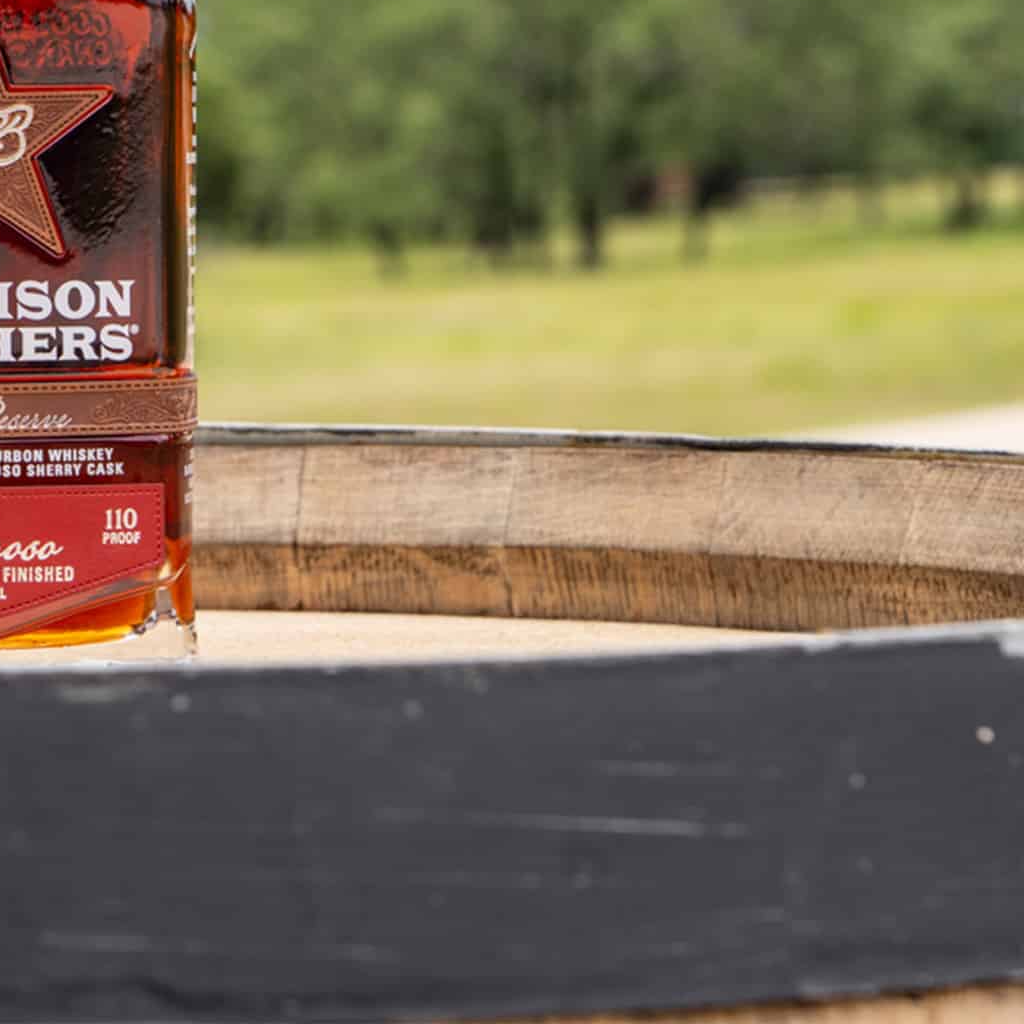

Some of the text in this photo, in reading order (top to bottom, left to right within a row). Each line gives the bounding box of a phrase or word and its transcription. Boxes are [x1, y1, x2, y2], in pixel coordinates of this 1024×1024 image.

[48, 448, 114, 461] WHISKEY
[26, 463, 82, 477] SHERRY
[86, 462, 125, 476] CASK
[105, 507, 138, 530] 110
[102, 531, 141, 545] PROOF
[2, 566, 75, 583] FINISHED
